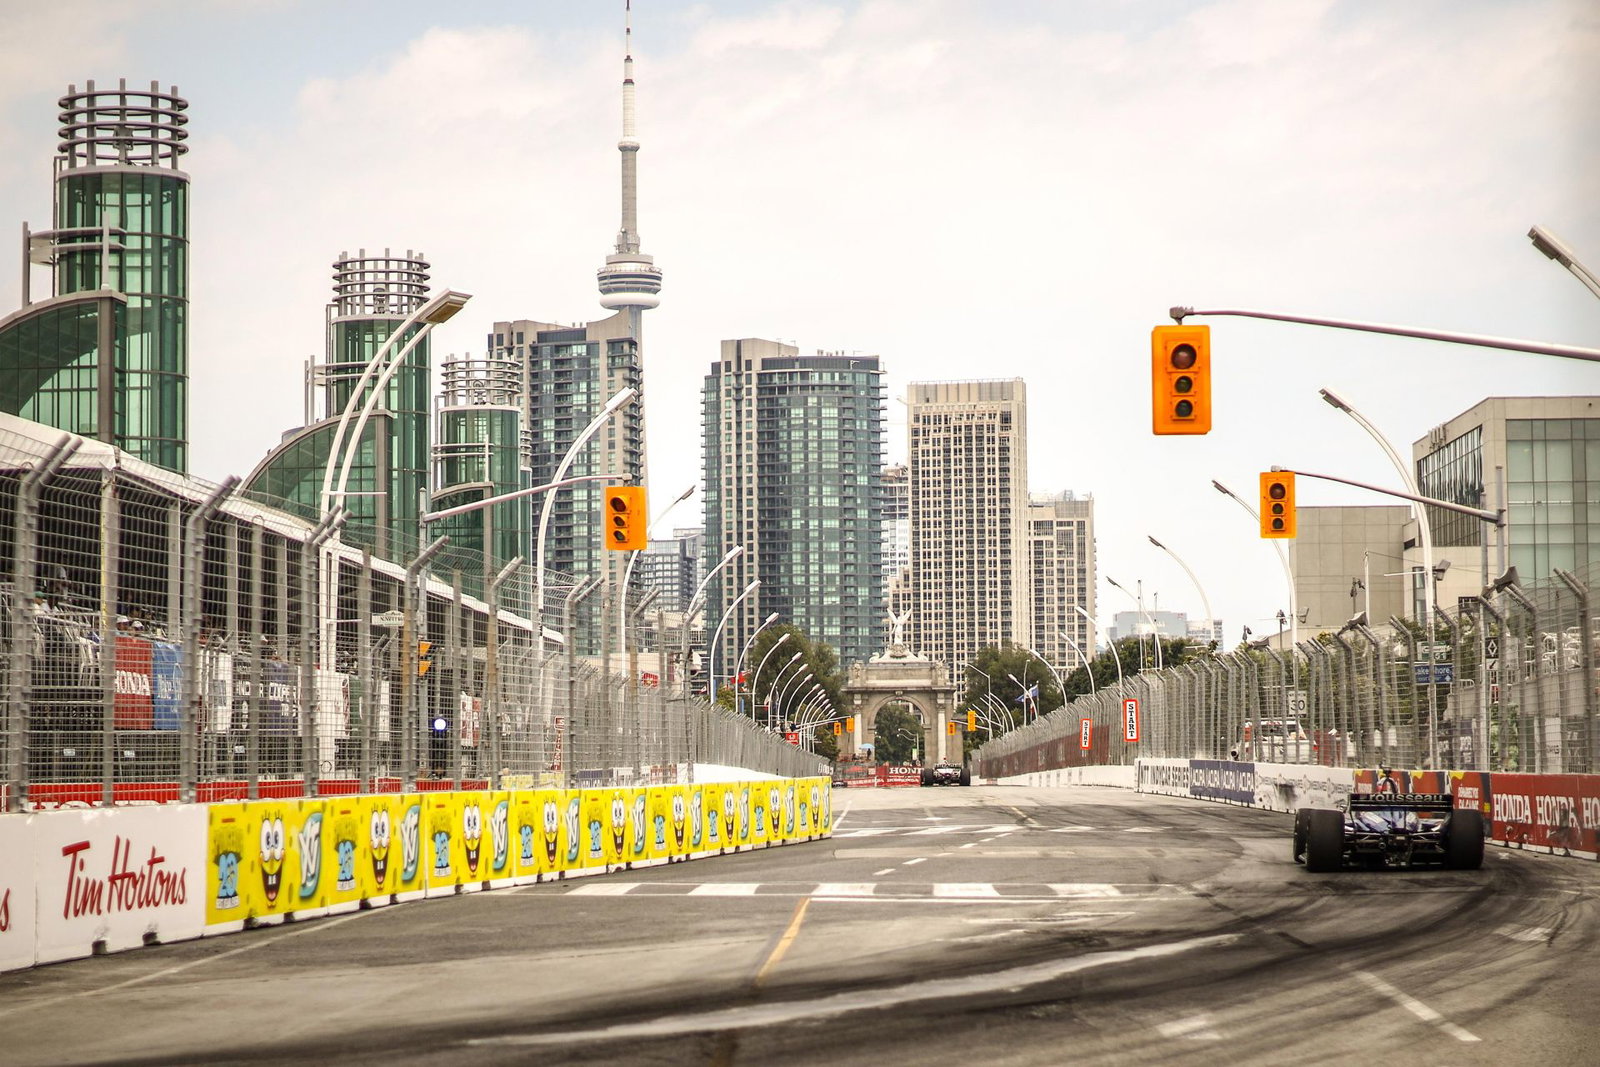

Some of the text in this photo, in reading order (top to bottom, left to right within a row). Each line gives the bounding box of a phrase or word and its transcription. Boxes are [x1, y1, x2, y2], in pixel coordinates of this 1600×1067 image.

[1369, 793, 1443, 803] rousseau
[1493, 793, 1532, 824] HONDA
[62, 834, 187, 920] Tim Hortons
